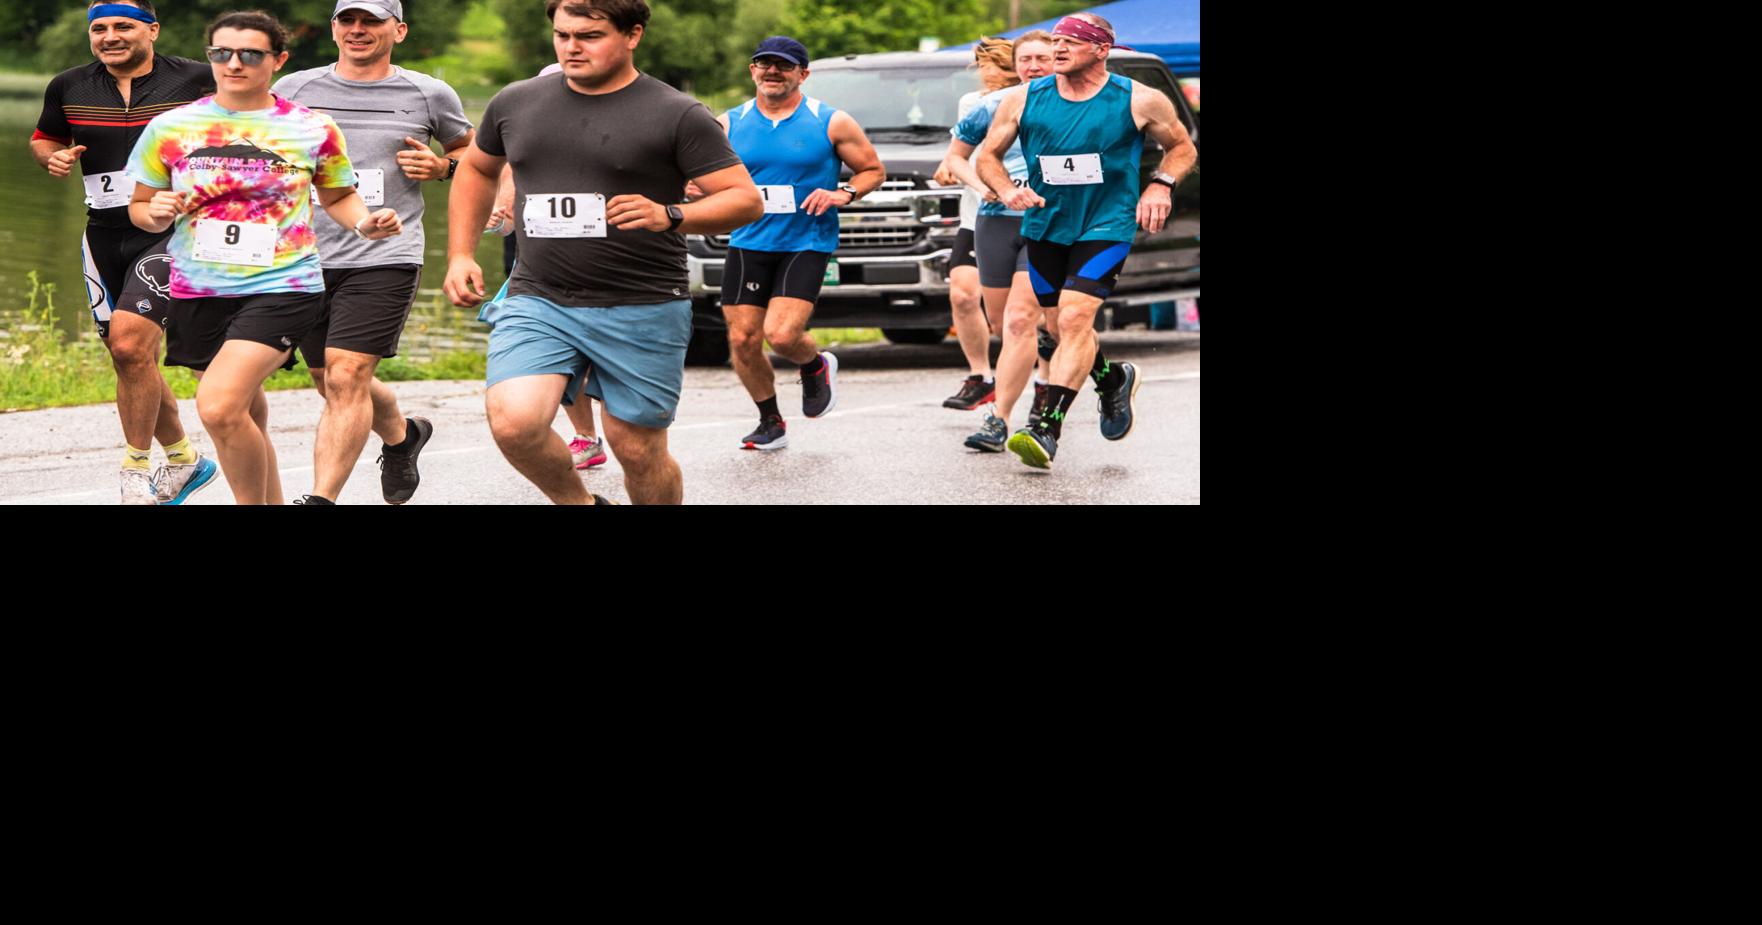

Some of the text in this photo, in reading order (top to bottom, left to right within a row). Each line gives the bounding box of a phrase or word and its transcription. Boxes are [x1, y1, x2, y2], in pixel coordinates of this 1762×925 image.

[189, 163, 299, 175] Colby Sawyer College
[1063, 157, 1075, 172] 4
[101, 175, 114, 193] 2
[761, 187, 769, 201] 1
[547, 197, 576, 218] 10
[225, 224, 240, 245] 9
